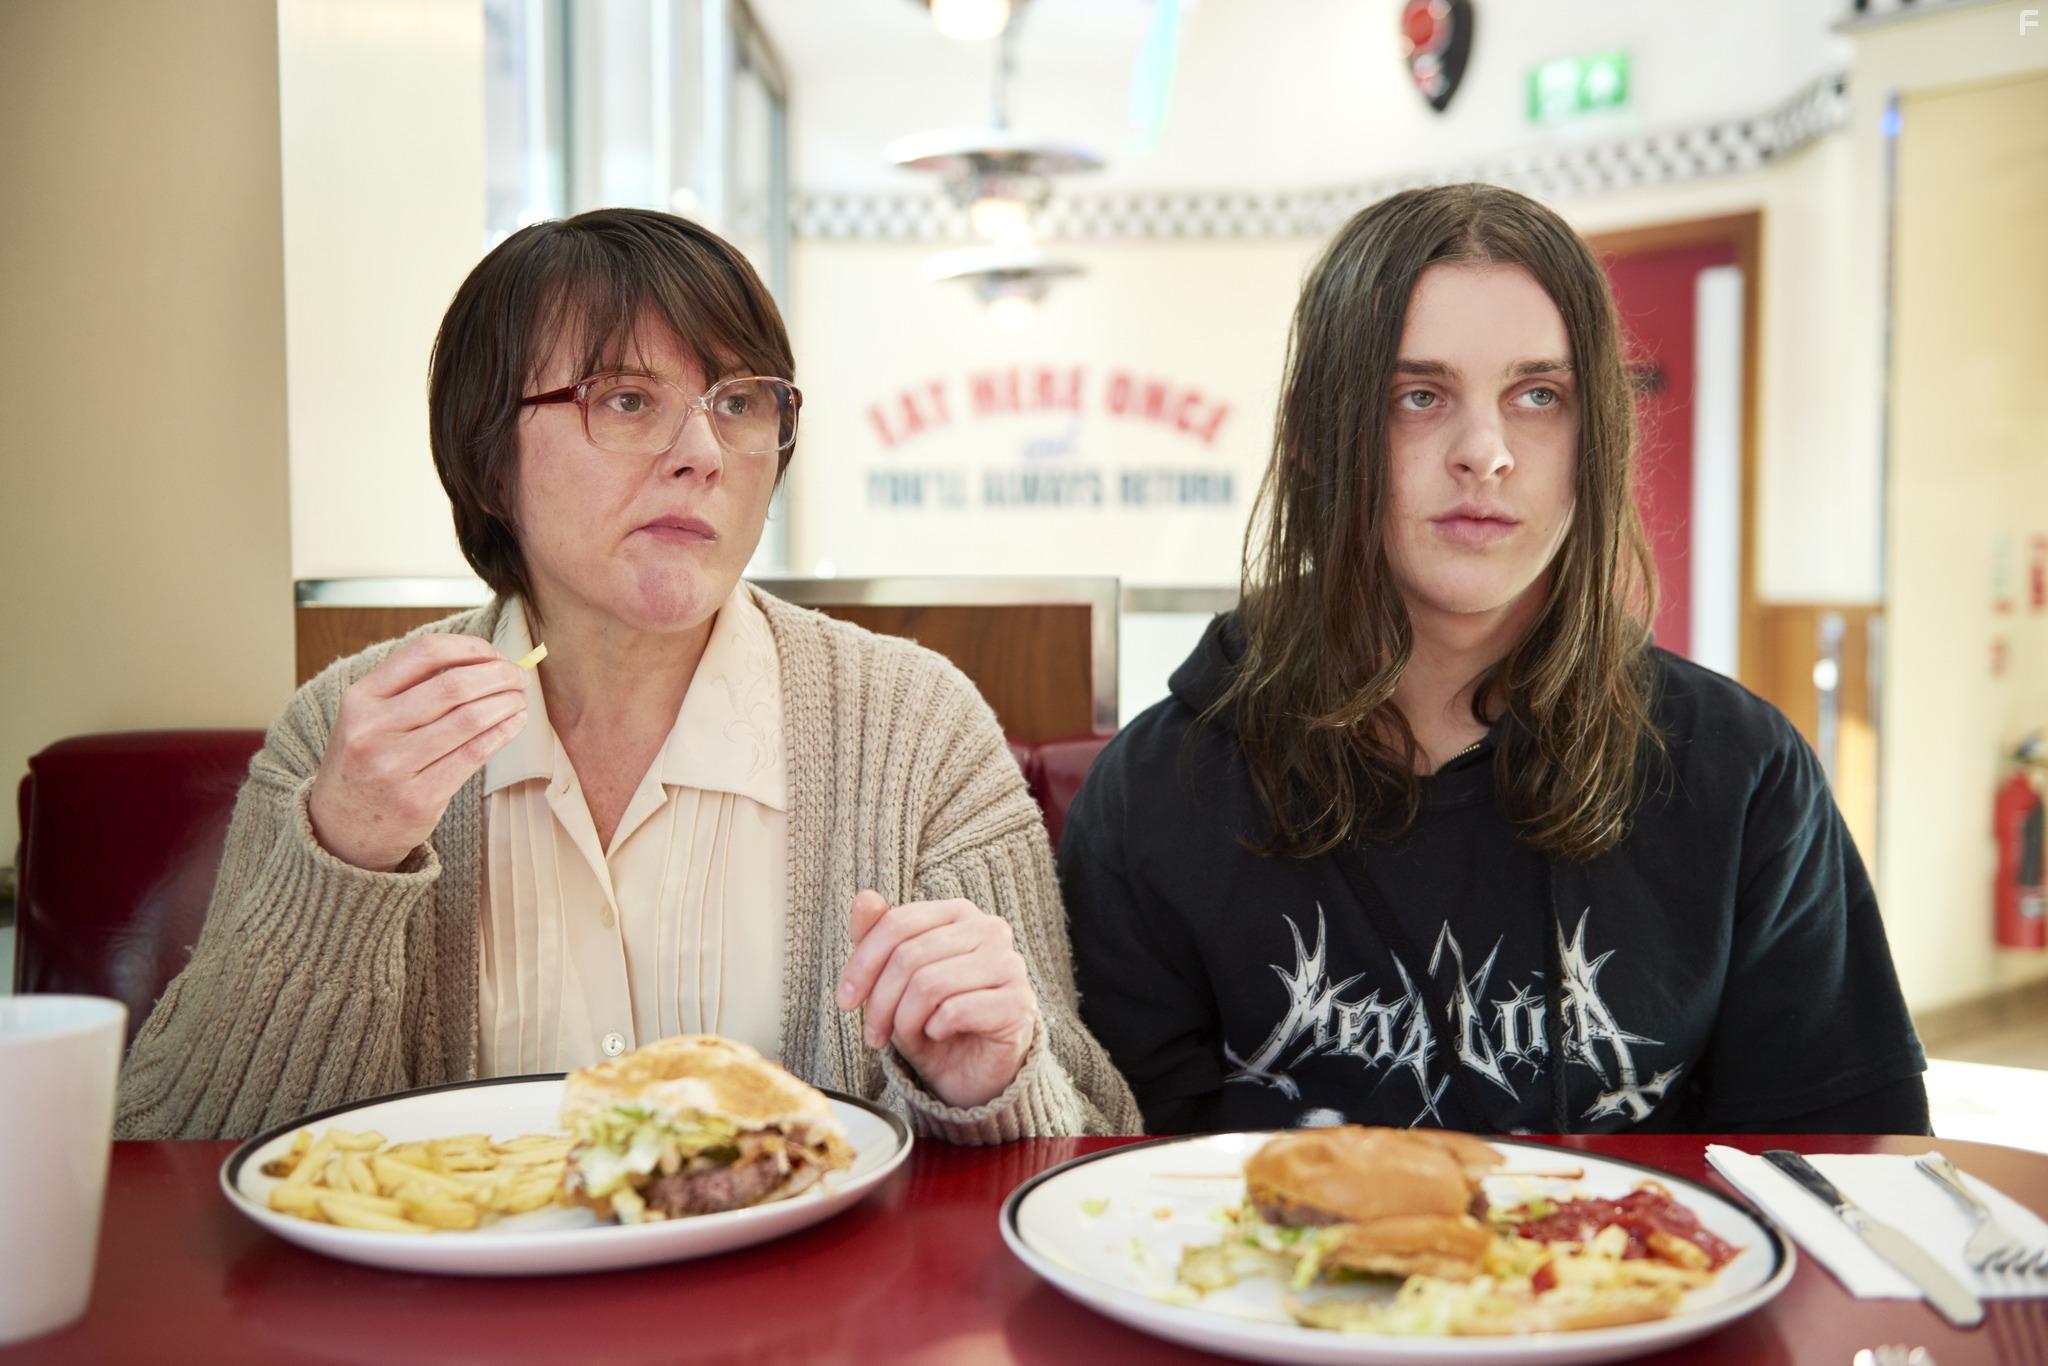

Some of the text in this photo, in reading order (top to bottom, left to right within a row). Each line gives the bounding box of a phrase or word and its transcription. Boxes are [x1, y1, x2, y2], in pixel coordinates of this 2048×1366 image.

[866, 363, 1233, 448] EAT HERE ONCE
[982, 469, 1103, 507] ALWAYS
[1118, 469, 1235, 507] RETURN
